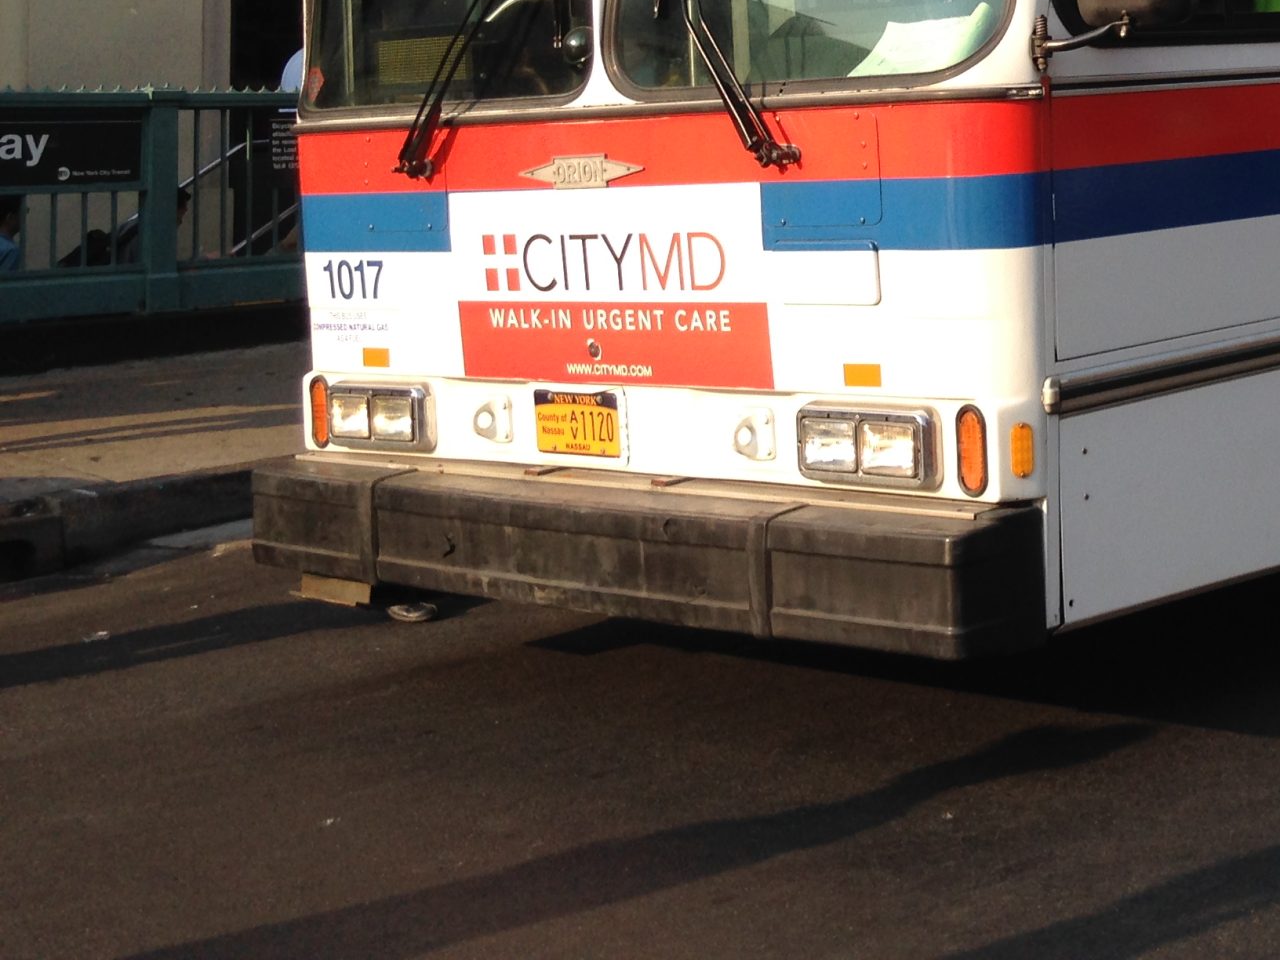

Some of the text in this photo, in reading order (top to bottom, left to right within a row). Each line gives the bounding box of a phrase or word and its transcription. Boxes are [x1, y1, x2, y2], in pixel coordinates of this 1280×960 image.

[555, 160, 605, 185] ORION
[522, 232, 726, 292] CITYMD
[323, 260, 383, 300] 1017
[489, 308, 732, 332] WALK-IN URGENT CARE
[567, 363, 653, 377] WWW.CITYMD.COM
[554, 393, 597, 406] NEW YORK
[537, 412, 567, 424] County of
[570, 410, 578, 424] A
[542, 426, 565, 436] Nassau
[580, 410, 614, 443] 1120
[565, 442, 591, 451] NASSAU
